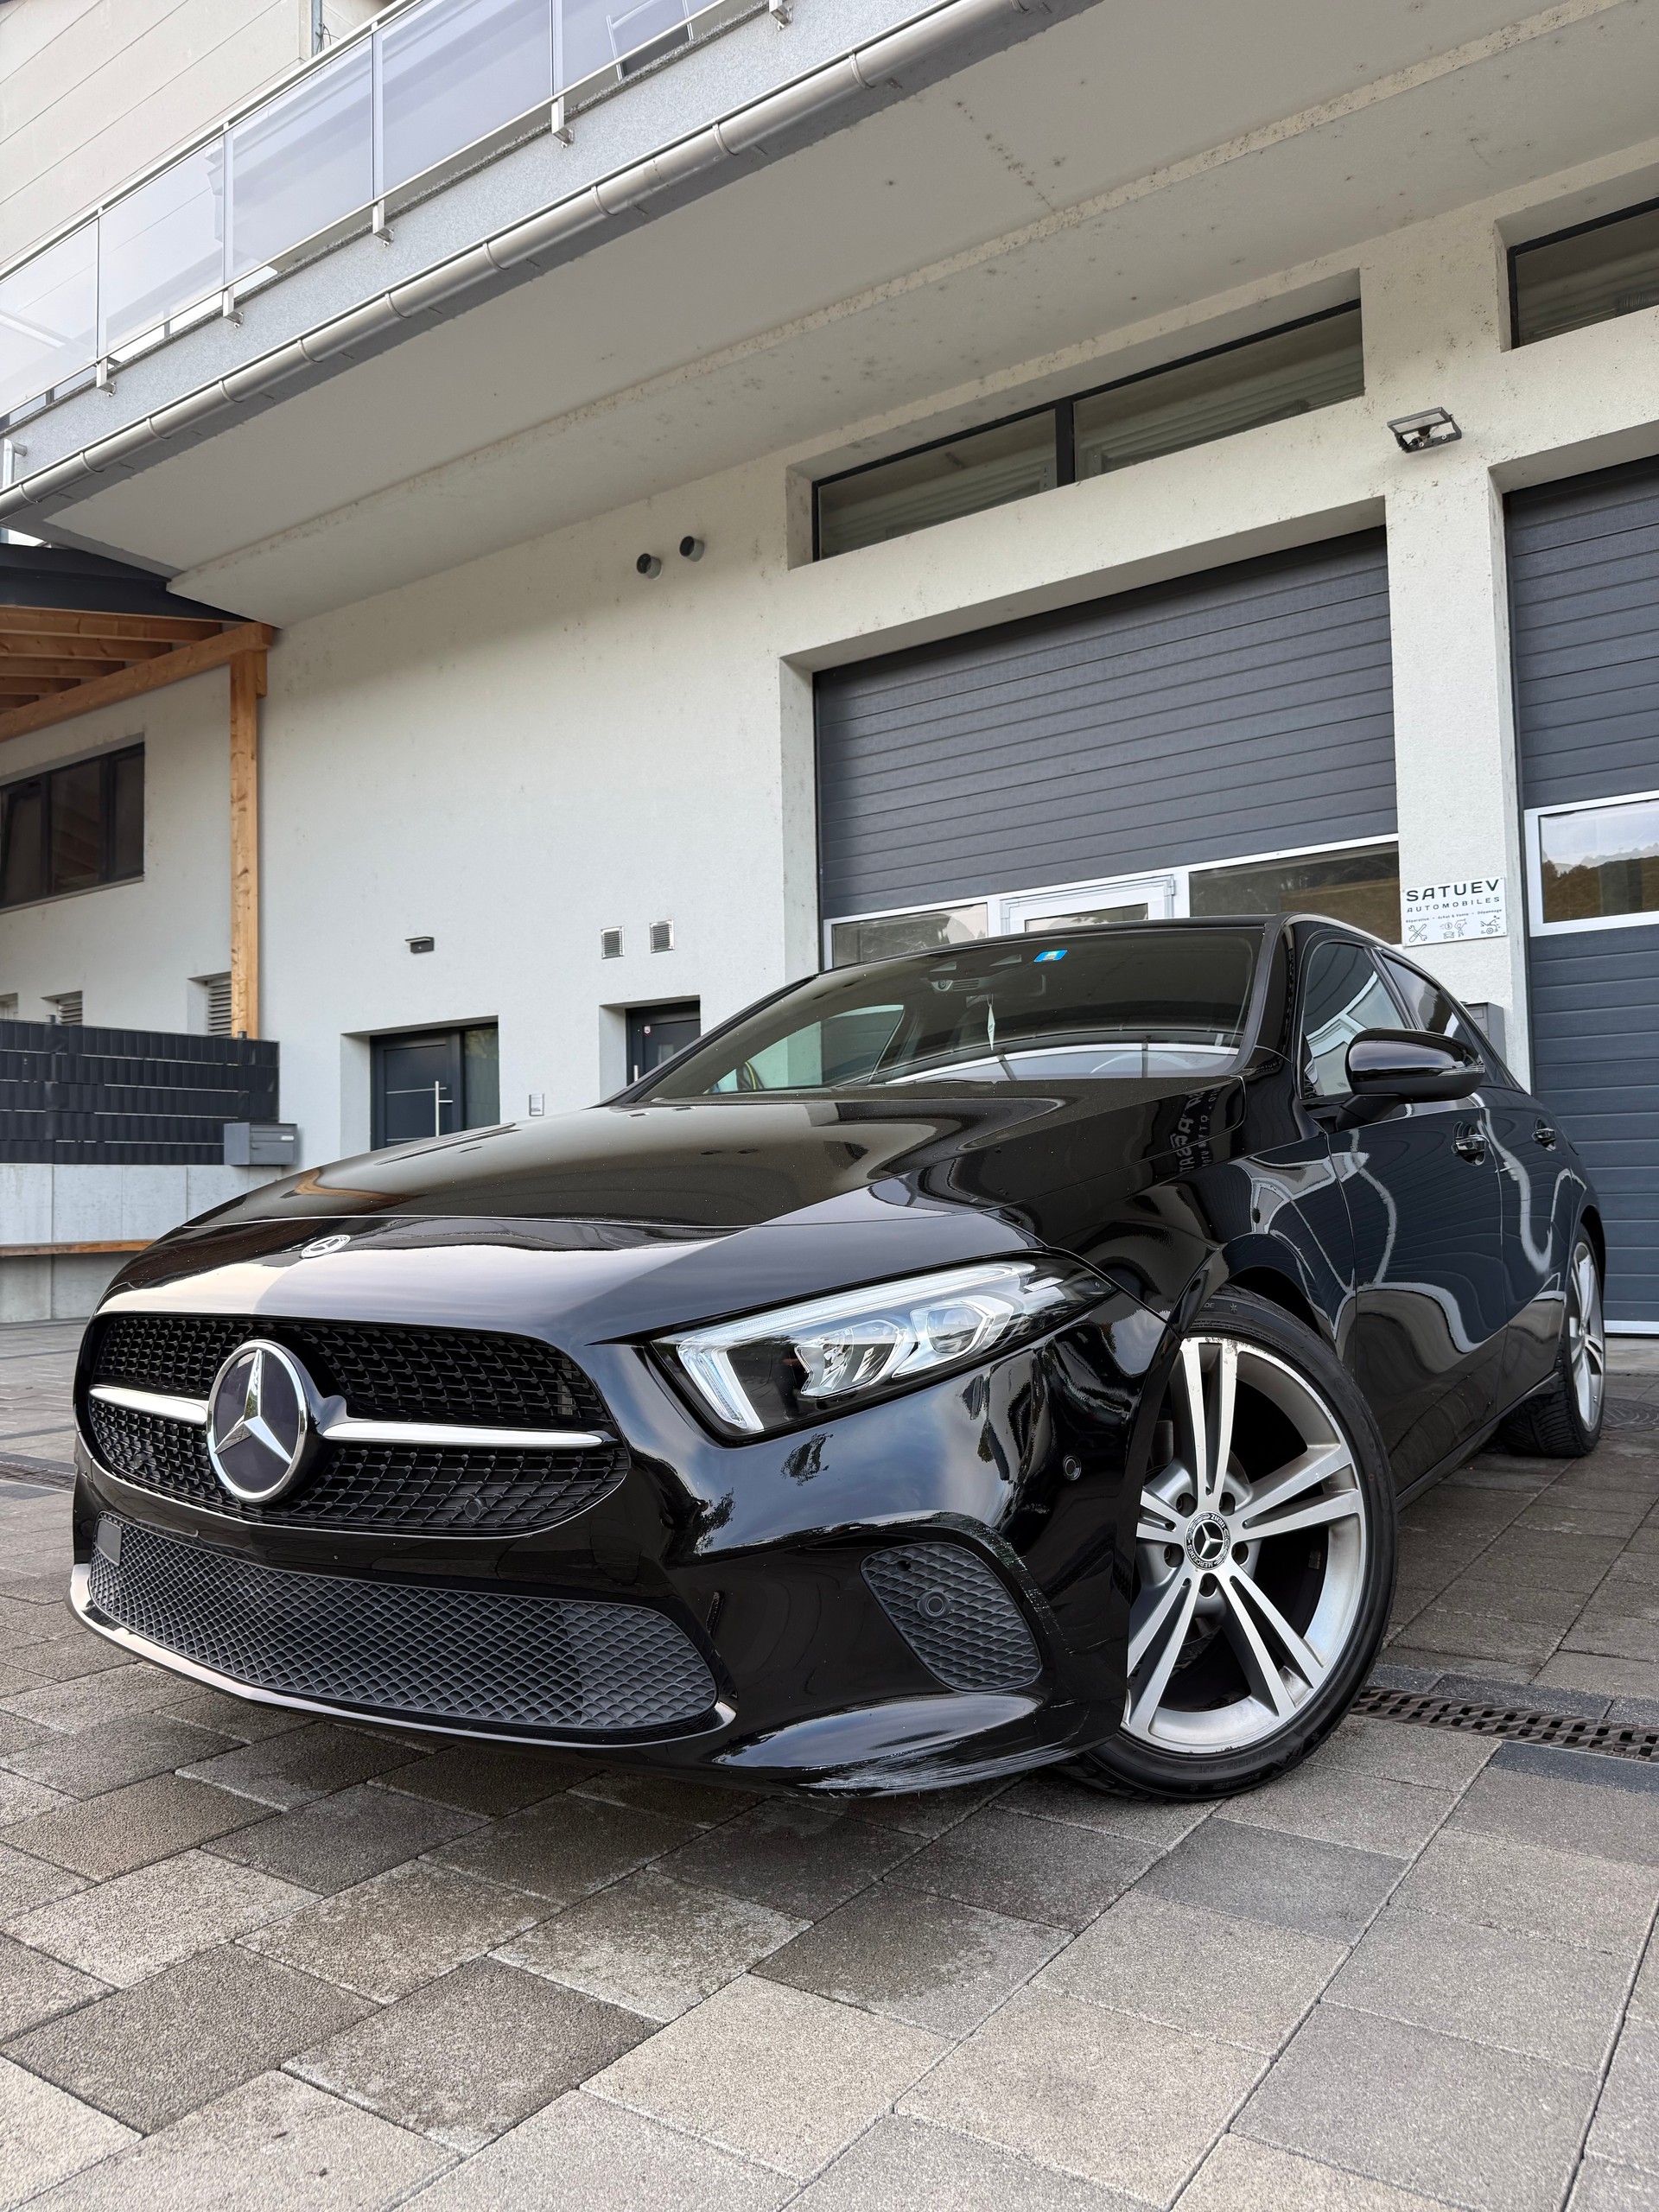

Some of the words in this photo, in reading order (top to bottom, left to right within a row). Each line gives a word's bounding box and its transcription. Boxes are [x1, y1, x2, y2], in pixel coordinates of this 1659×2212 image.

[1406, 879, 1499, 901] SATUEV
[1407, 896, 1500, 912] AUTOMOBILES
[1186, 1544, 1214, 1568] MERCEDES
